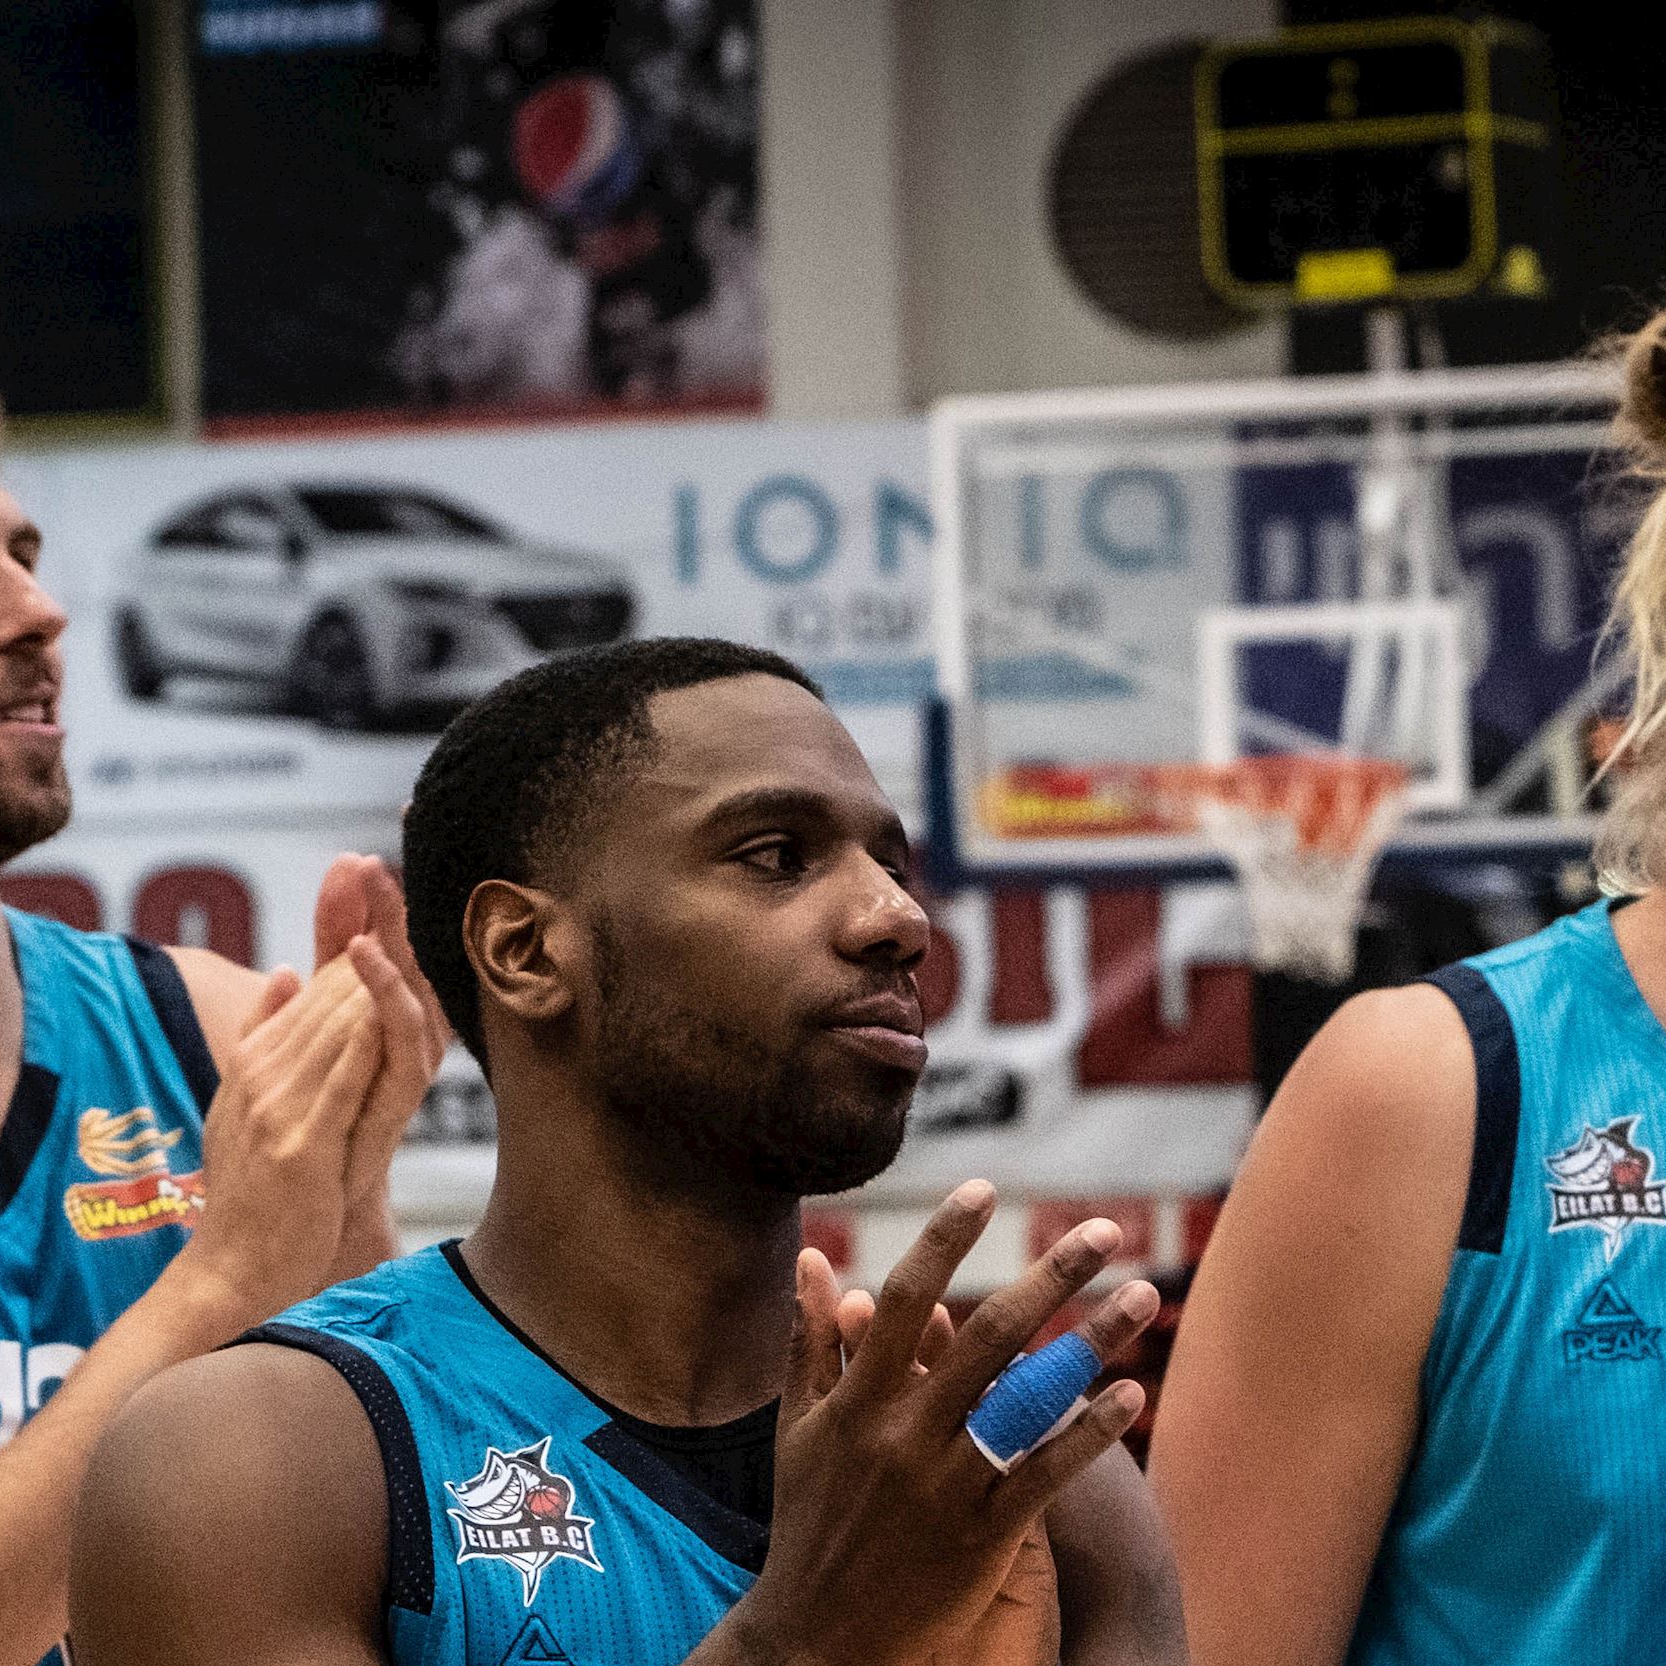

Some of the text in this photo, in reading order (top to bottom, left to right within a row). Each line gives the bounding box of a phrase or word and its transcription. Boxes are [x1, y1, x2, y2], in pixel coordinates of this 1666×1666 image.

[1563, 1323, 1664, 1363] PEAK
[466, 1526, 585, 1552] EILAT B.C
